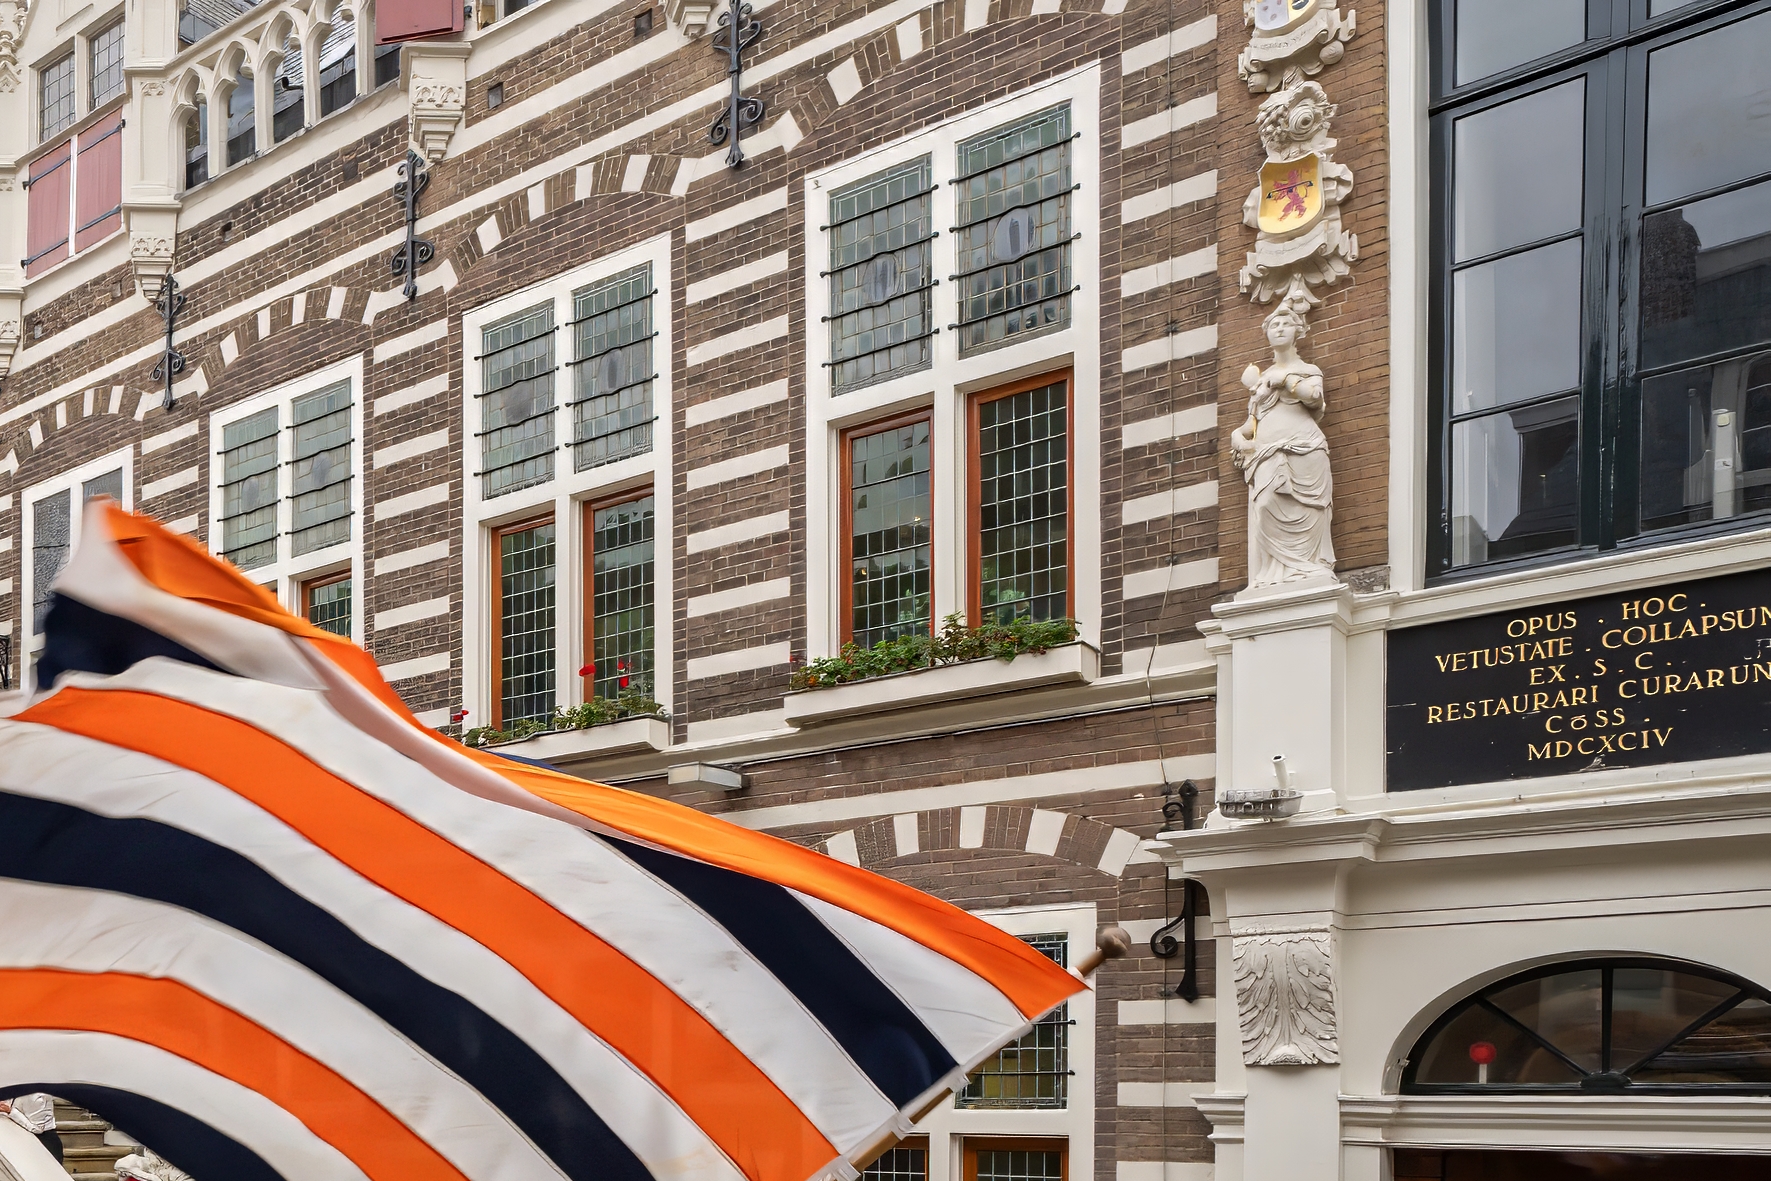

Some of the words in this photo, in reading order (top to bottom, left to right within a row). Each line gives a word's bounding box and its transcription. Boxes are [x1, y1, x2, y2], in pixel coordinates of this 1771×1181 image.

[1506, 611, 1577, 638] OPUS
[1621, 593, 1688, 621] HOC
[1435, 636, 1574, 673] VETUSTATE
[1427, 684, 1599, 724] RESTAURARI
[1528, 727, 1674, 761] MDCXCIV
